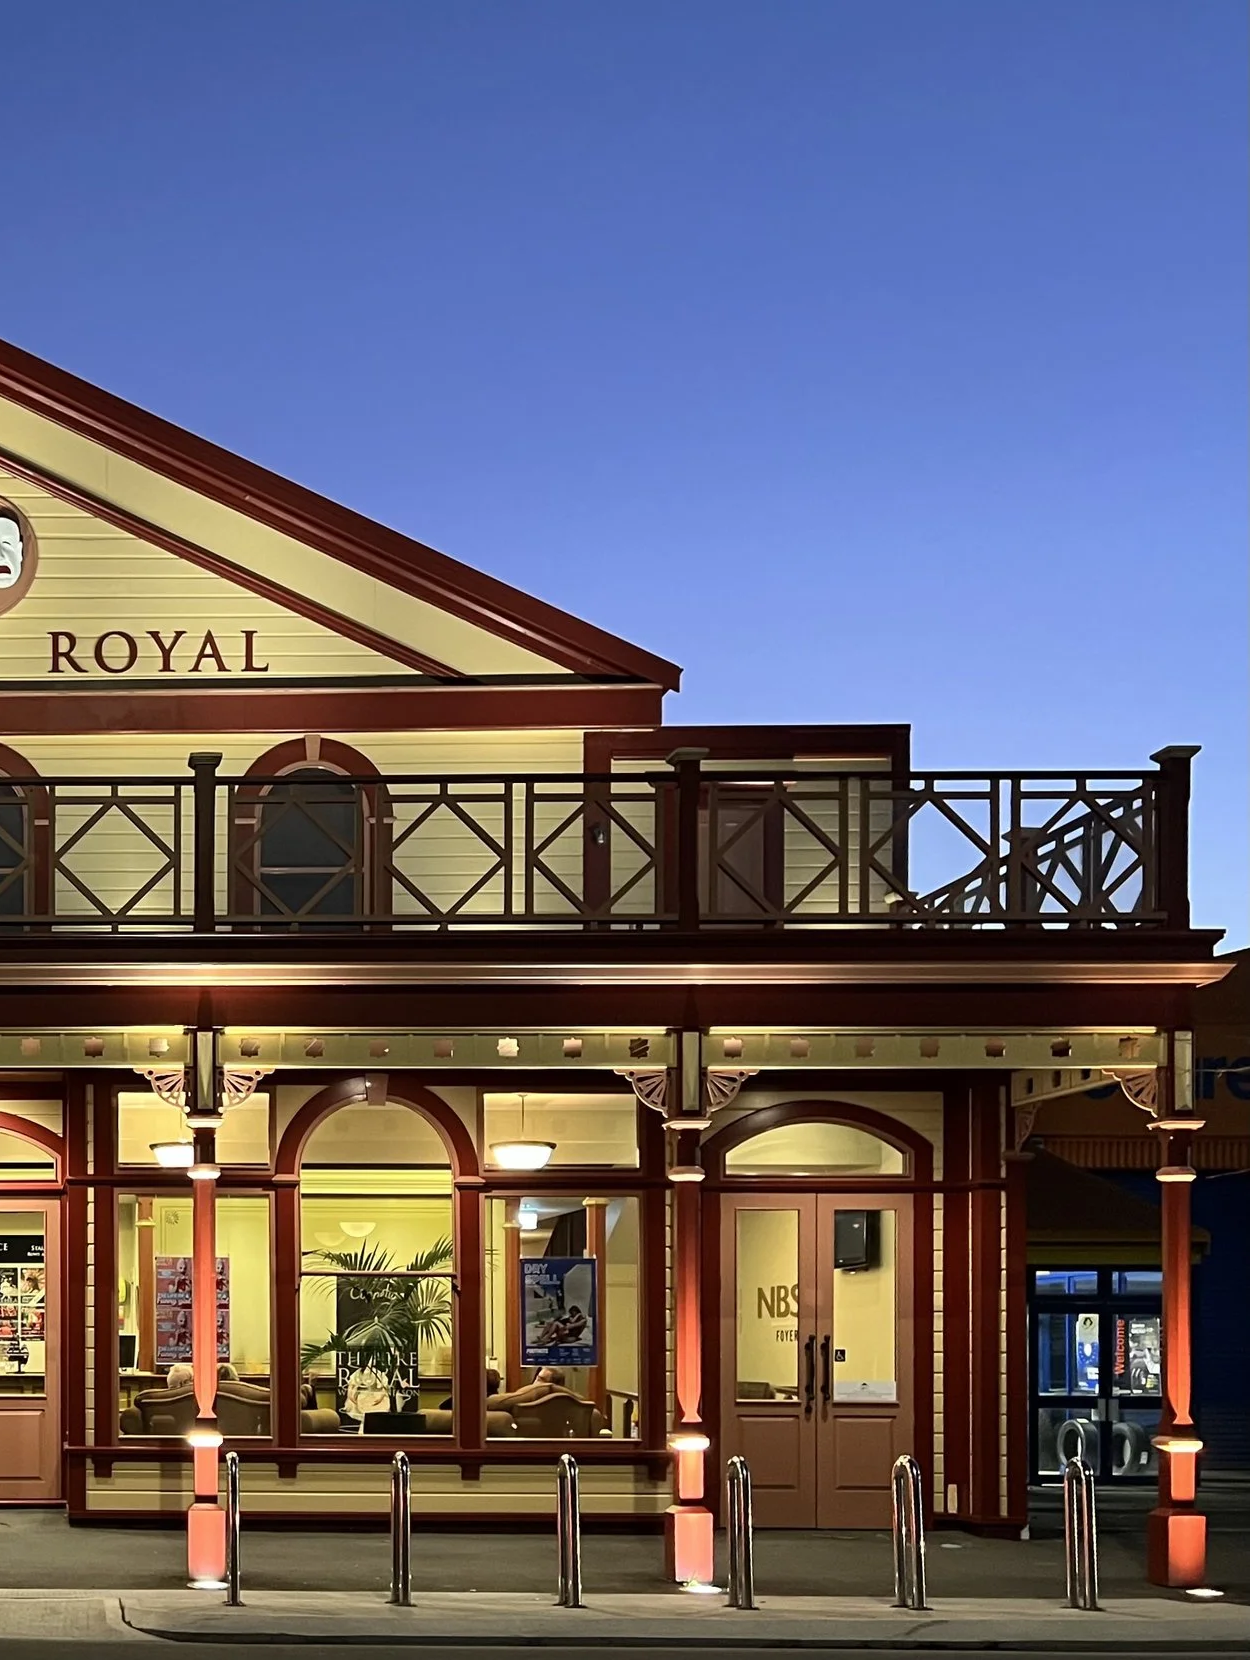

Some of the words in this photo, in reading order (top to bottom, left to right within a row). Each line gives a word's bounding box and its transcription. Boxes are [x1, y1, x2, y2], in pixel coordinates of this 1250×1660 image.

[47, 629, 269, 674] ROYAL
[524, 1263, 548, 1274] DRY
[757, 1283, 798, 1319] NBS
[776, 1329, 799, 1343] FOYER
[1113, 1319, 1125, 1375] Welcome
[336, 1351, 418, 1367] THTRE
[337, 1367, 421, 1388] ROAL
